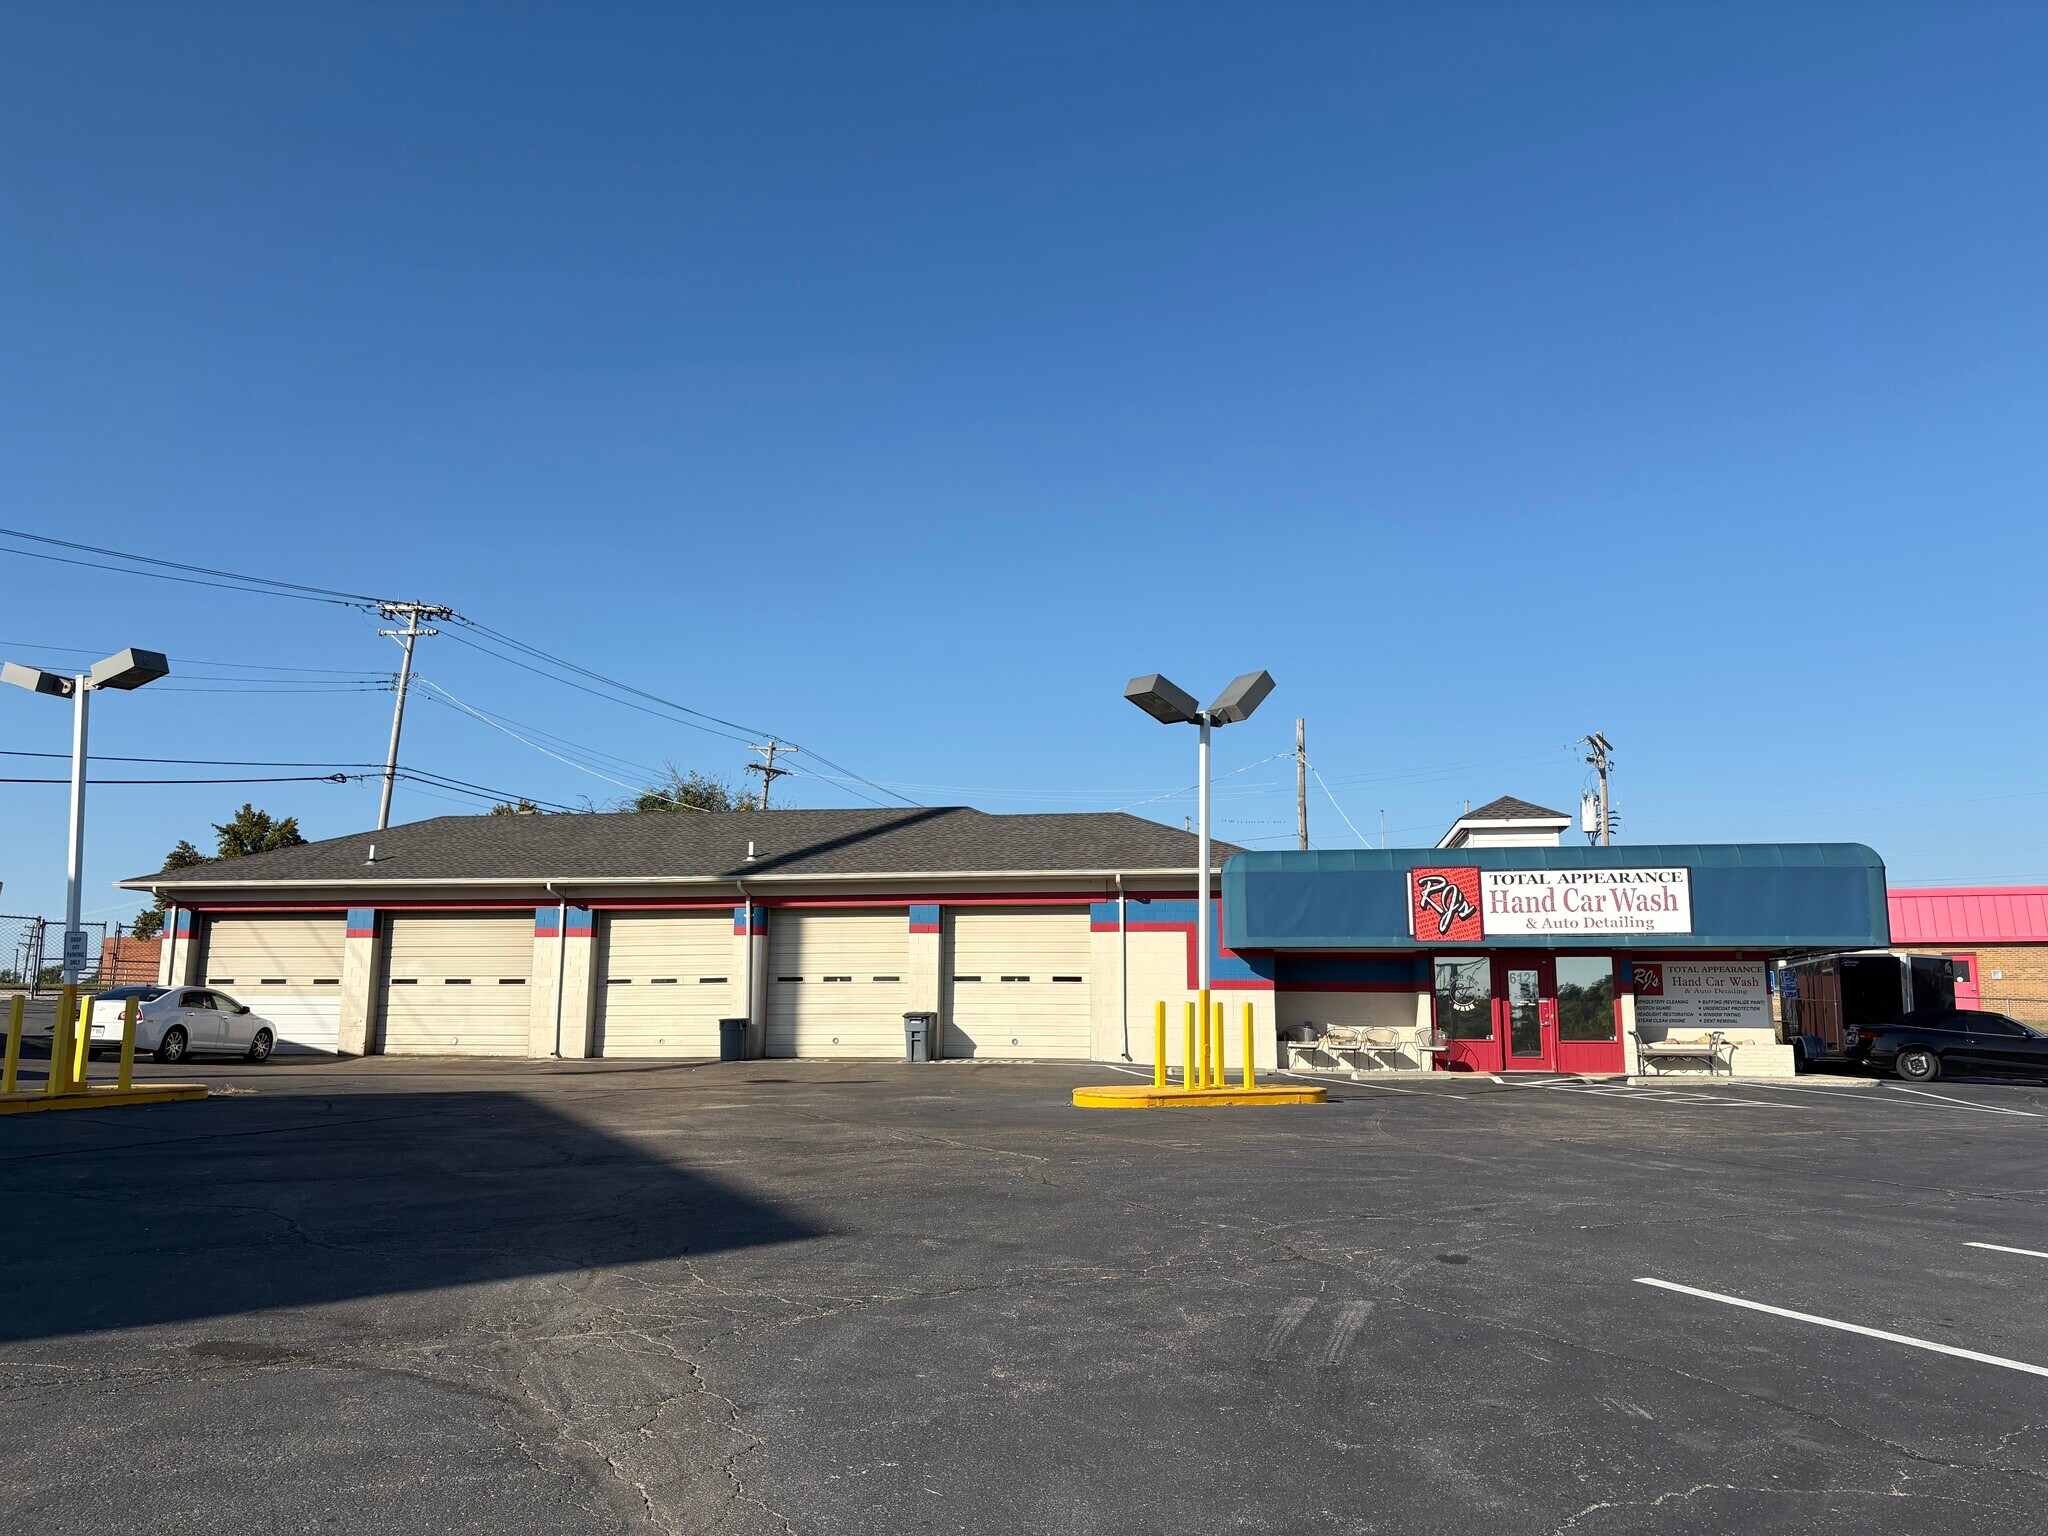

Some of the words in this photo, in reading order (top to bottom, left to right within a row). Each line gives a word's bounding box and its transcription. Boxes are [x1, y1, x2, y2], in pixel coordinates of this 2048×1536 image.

[1489, 873, 1551, 885] TOTAL
[1557, 871, 1683, 884] APPEARANCE
[1489, 887, 1557, 913] Hand
[1563, 887, 1607, 912] Car
[1609, 885, 1679, 912] Wash
[1526, 918, 1538, 929] &
[1542, 917, 1579, 928] Auto
[1583, 916, 1655, 931] Detailing
[1510, 972, 1537, 984] 6121
[1672, 976, 1701, 987] Hand
[1706, 977, 1725, 987] Car
[1729, 976, 1759, 987] Wash
[1714, 987, 1748, 995] Detailing
[1453, 1003, 1475, 1011] WASH
